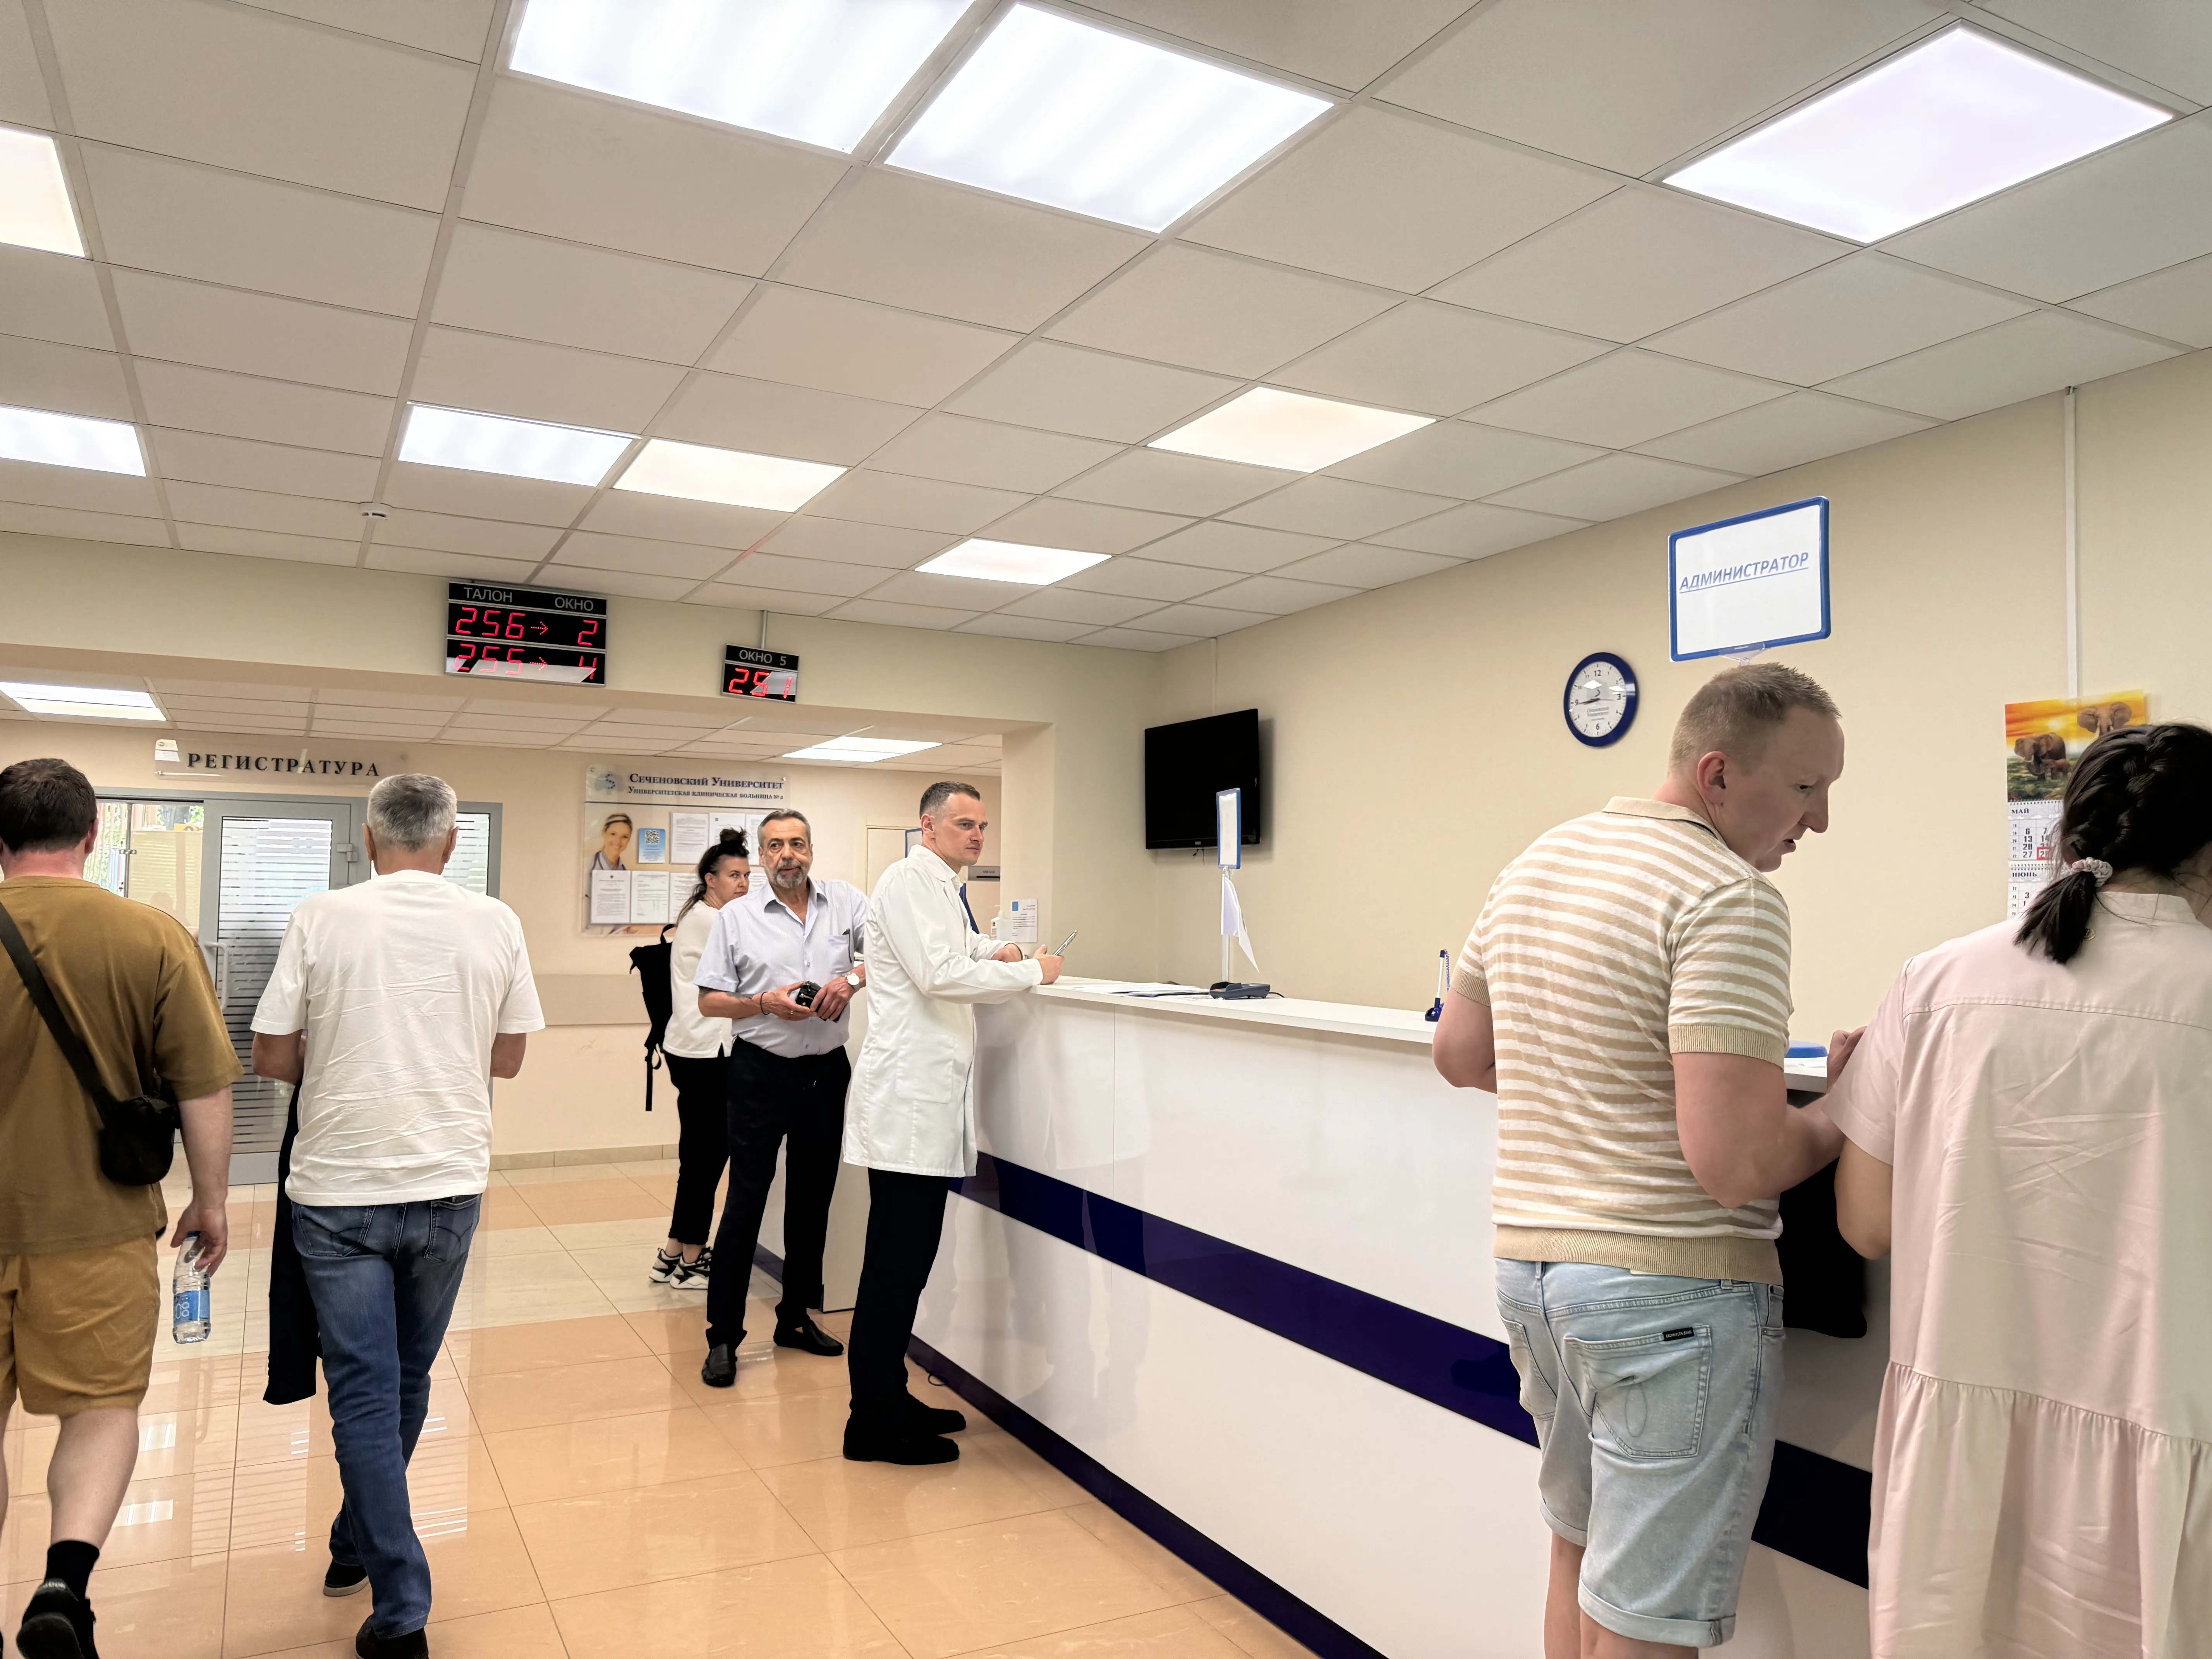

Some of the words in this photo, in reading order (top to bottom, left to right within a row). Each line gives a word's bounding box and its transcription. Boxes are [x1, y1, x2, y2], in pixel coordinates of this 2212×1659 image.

[1679, 552, 1809, 591] АДМИНИСТРАТОР
[464, 587, 512, 603] ТАЛОН
[555, 597, 594, 611] ОКНО
[455, 607, 526, 639] 256
[577, 620, 598, 646] 2
[454, 643, 525, 675] 255
[579, 655, 597, 680] 4
[739, 649, 773, 663] ОКНО
[779, 656, 787, 666] 5
[728, 668, 793, 699] 251
[187, 752, 380, 776] РЕГИСТРАТУРА
